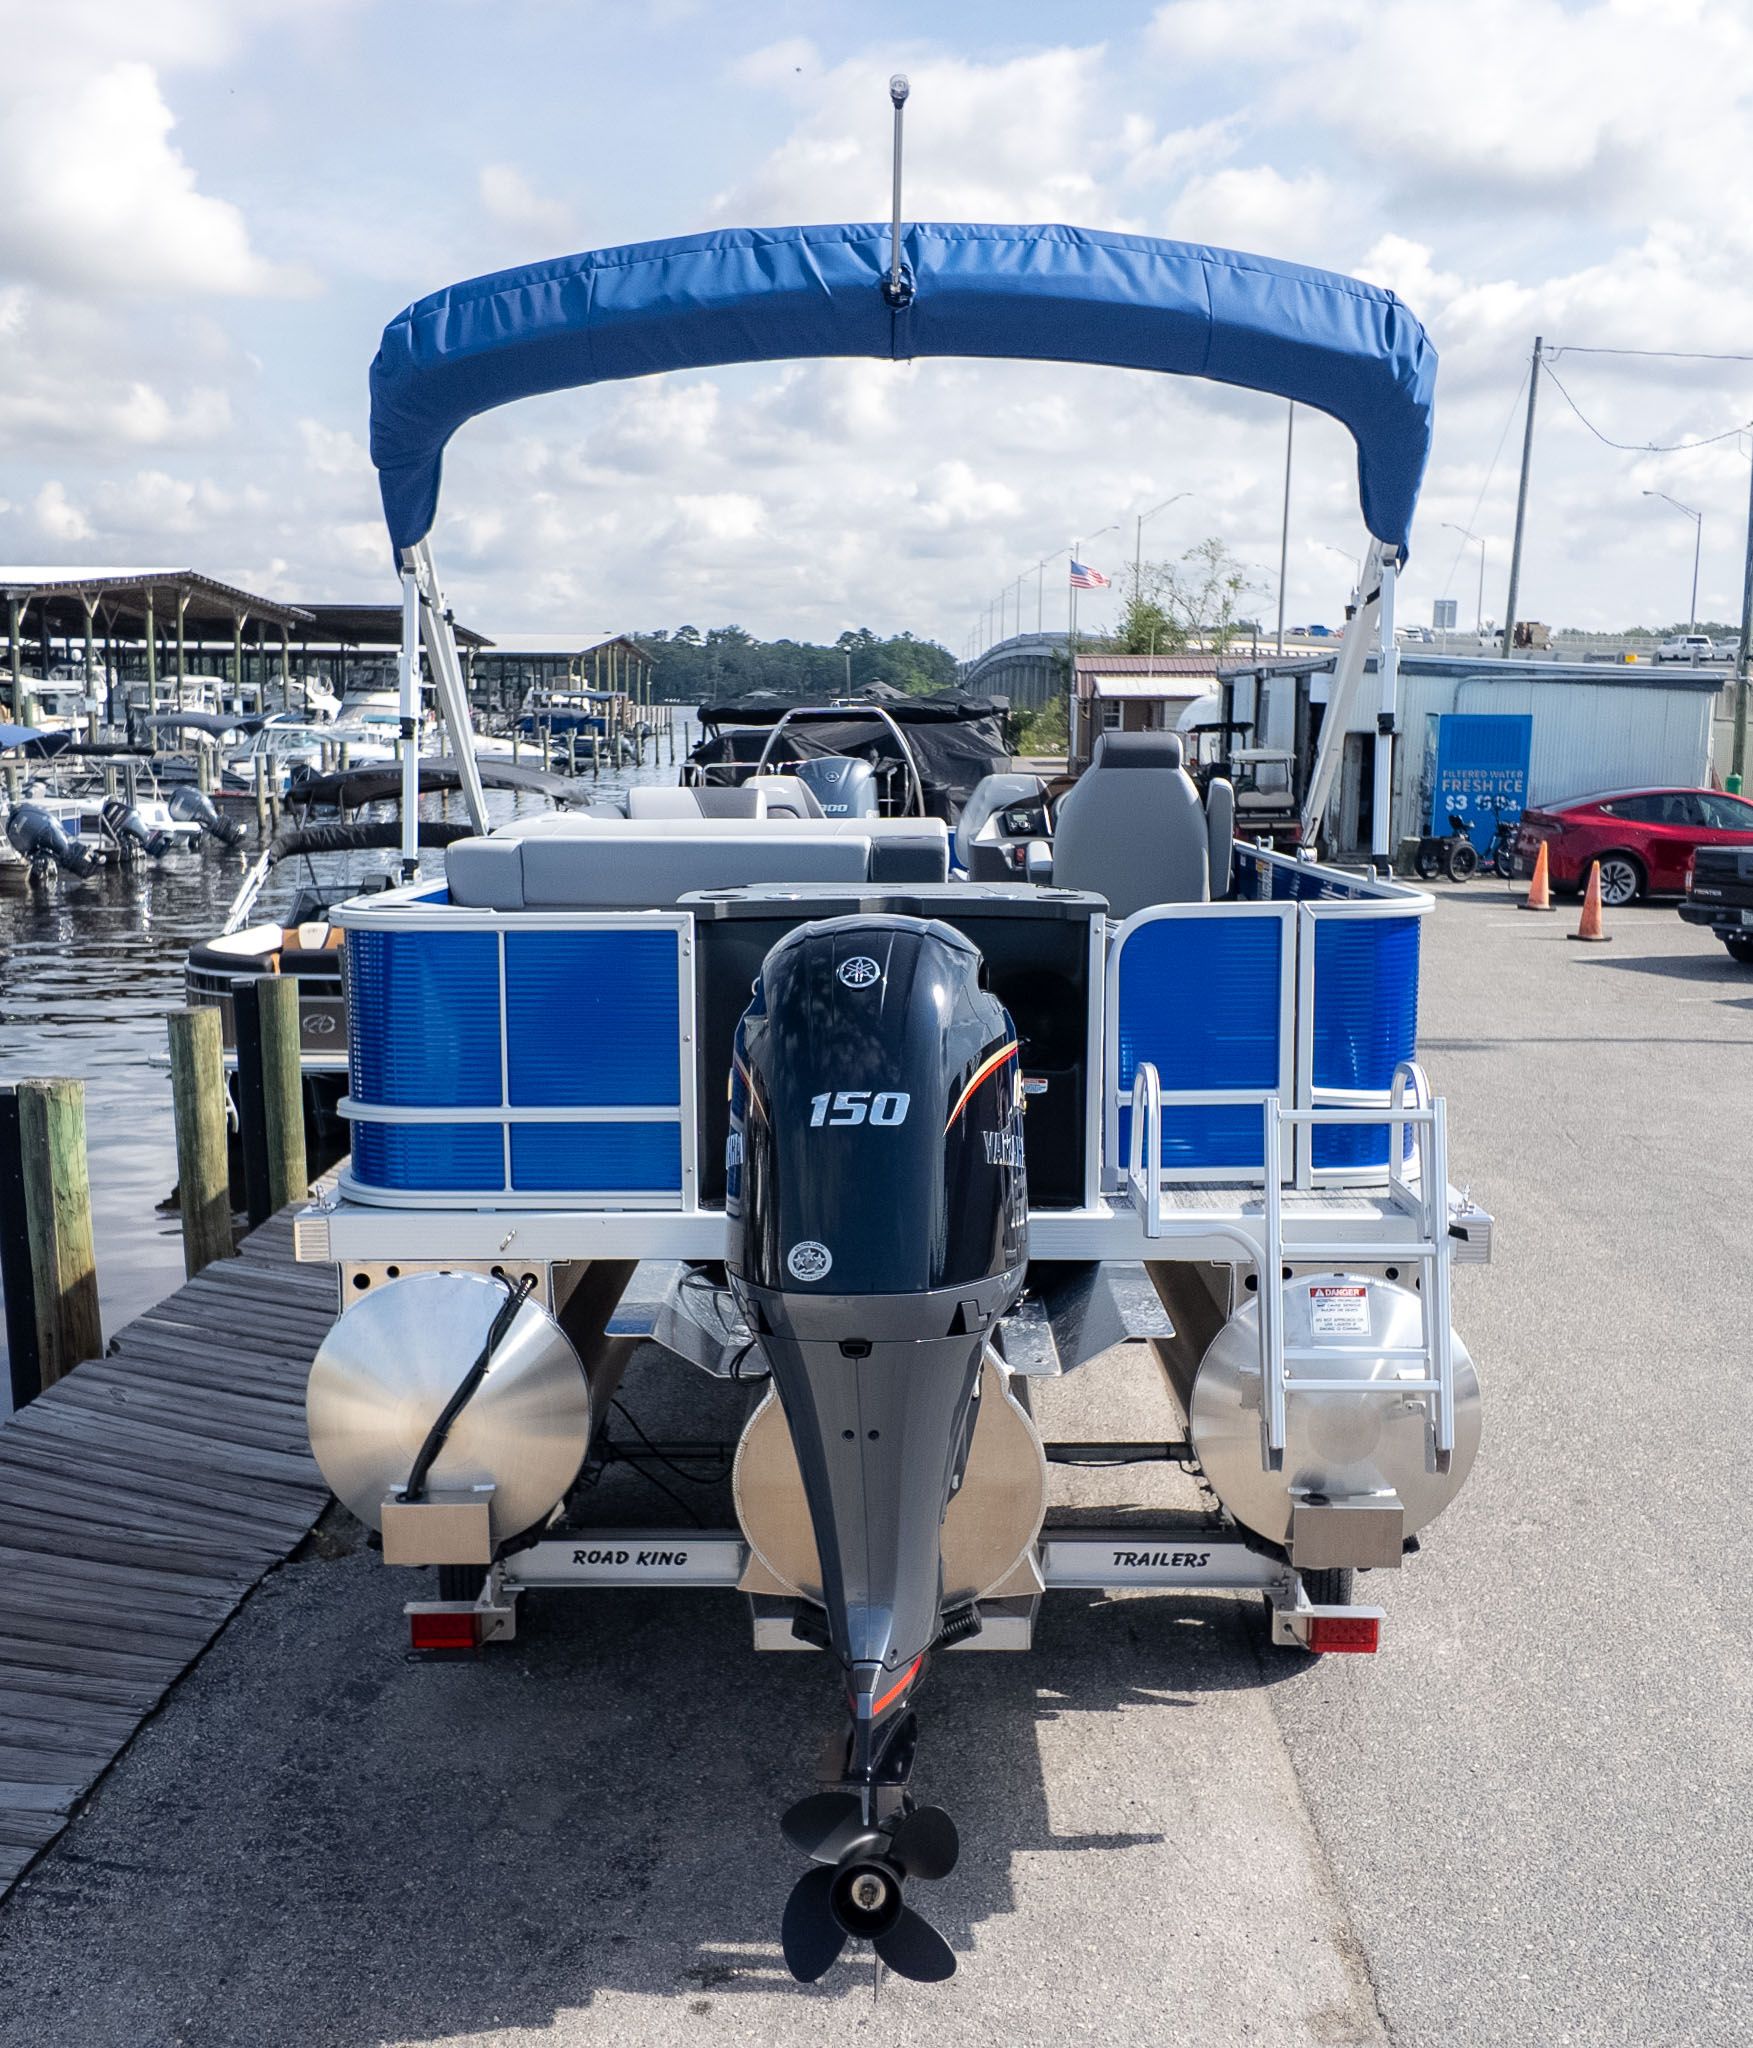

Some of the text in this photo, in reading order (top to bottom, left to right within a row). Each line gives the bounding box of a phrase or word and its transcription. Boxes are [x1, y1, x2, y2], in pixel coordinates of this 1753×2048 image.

[1442, 769, 1524, 779] FILTERED WATER
[1442, 780, 1523, 793] FRESH ICE
[1445, 795, 1468, 812] $3
[809, 1091, 911, 1127] 150
[1325, 1288, 1360, 1297] DANGER
[572, 1549, 689, 1567] ROAD KING
[1112, 1551, 1211, 1568] TRAILERS
